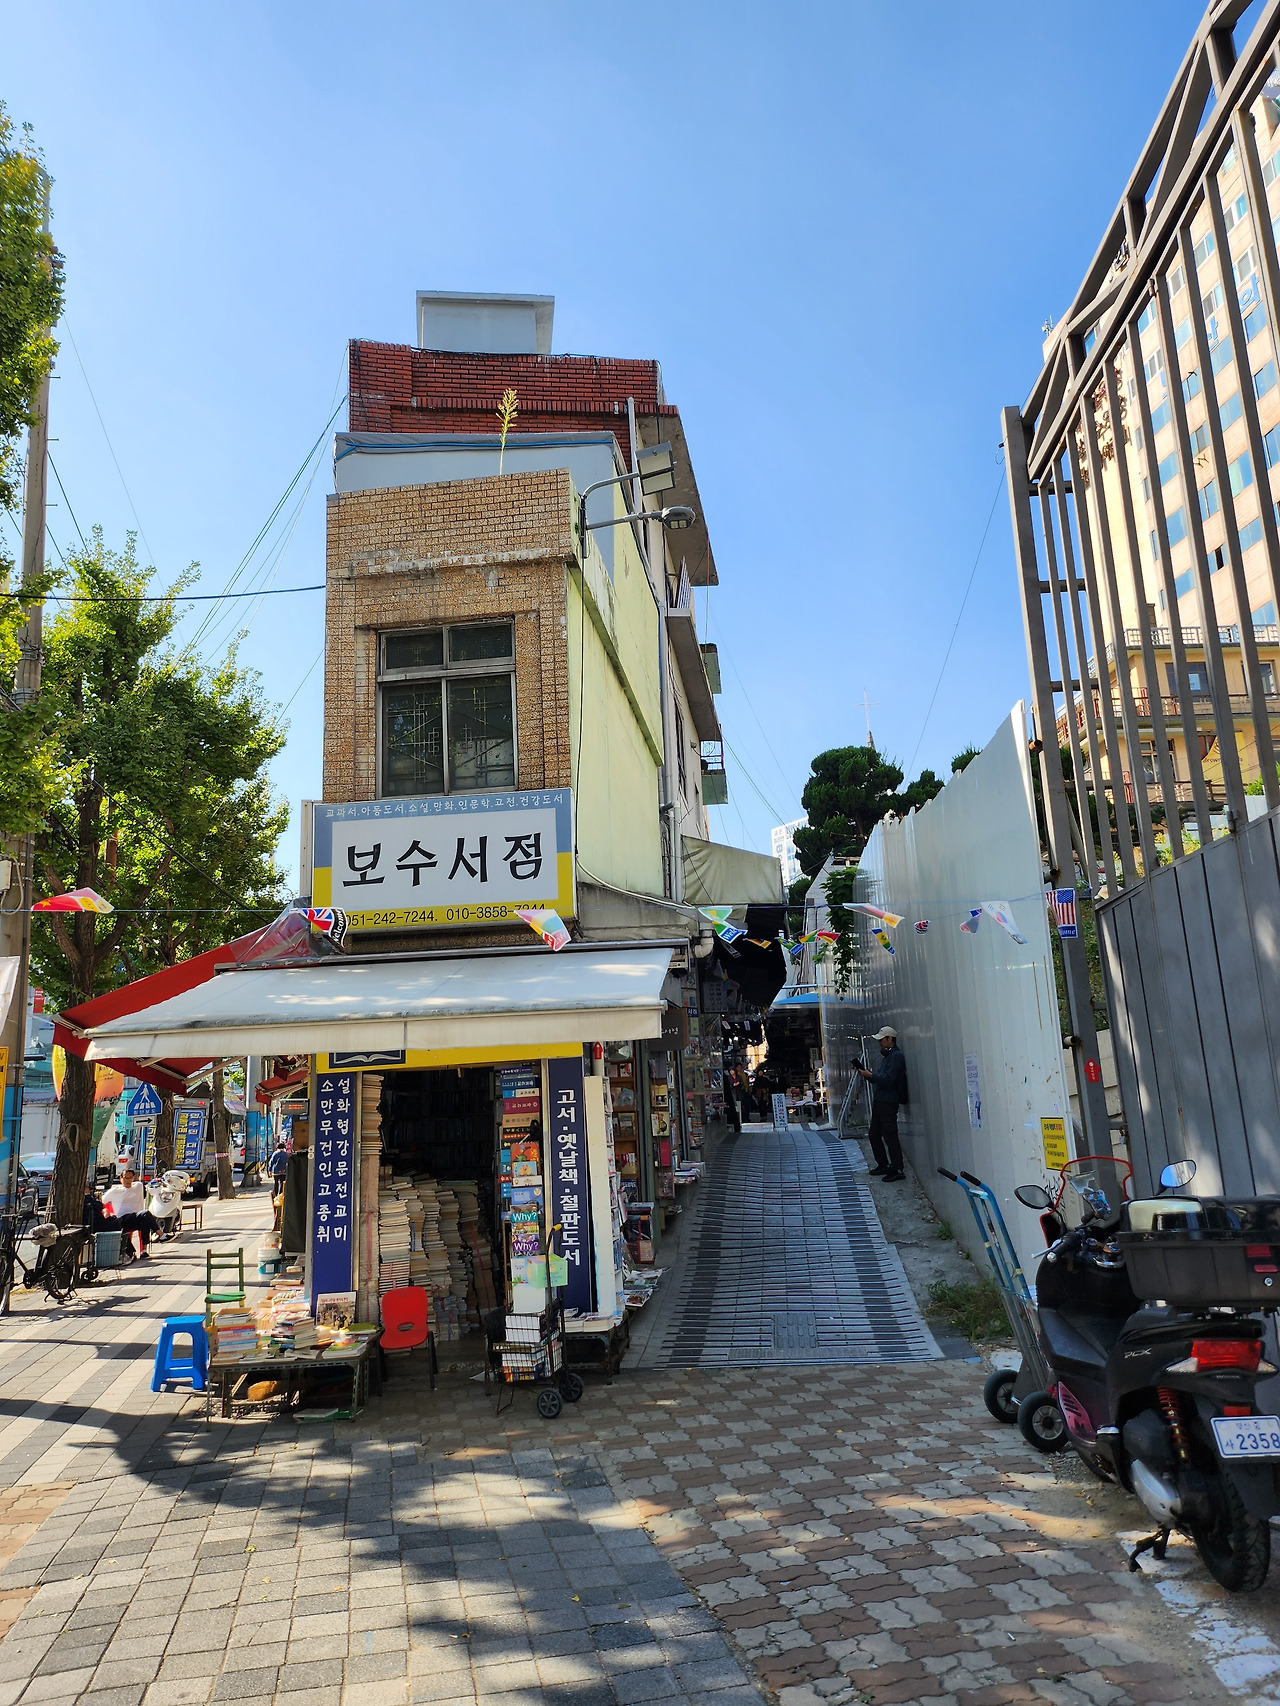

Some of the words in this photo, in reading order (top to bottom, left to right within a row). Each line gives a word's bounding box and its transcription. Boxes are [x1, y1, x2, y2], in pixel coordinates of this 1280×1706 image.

[343, 832, 543, 887] 보수서점
[512, 1211, 537, 1222] Why?
[513, 1241, 539, 1251] Why?
[1236, 1433, 1280, 1450] 2358
